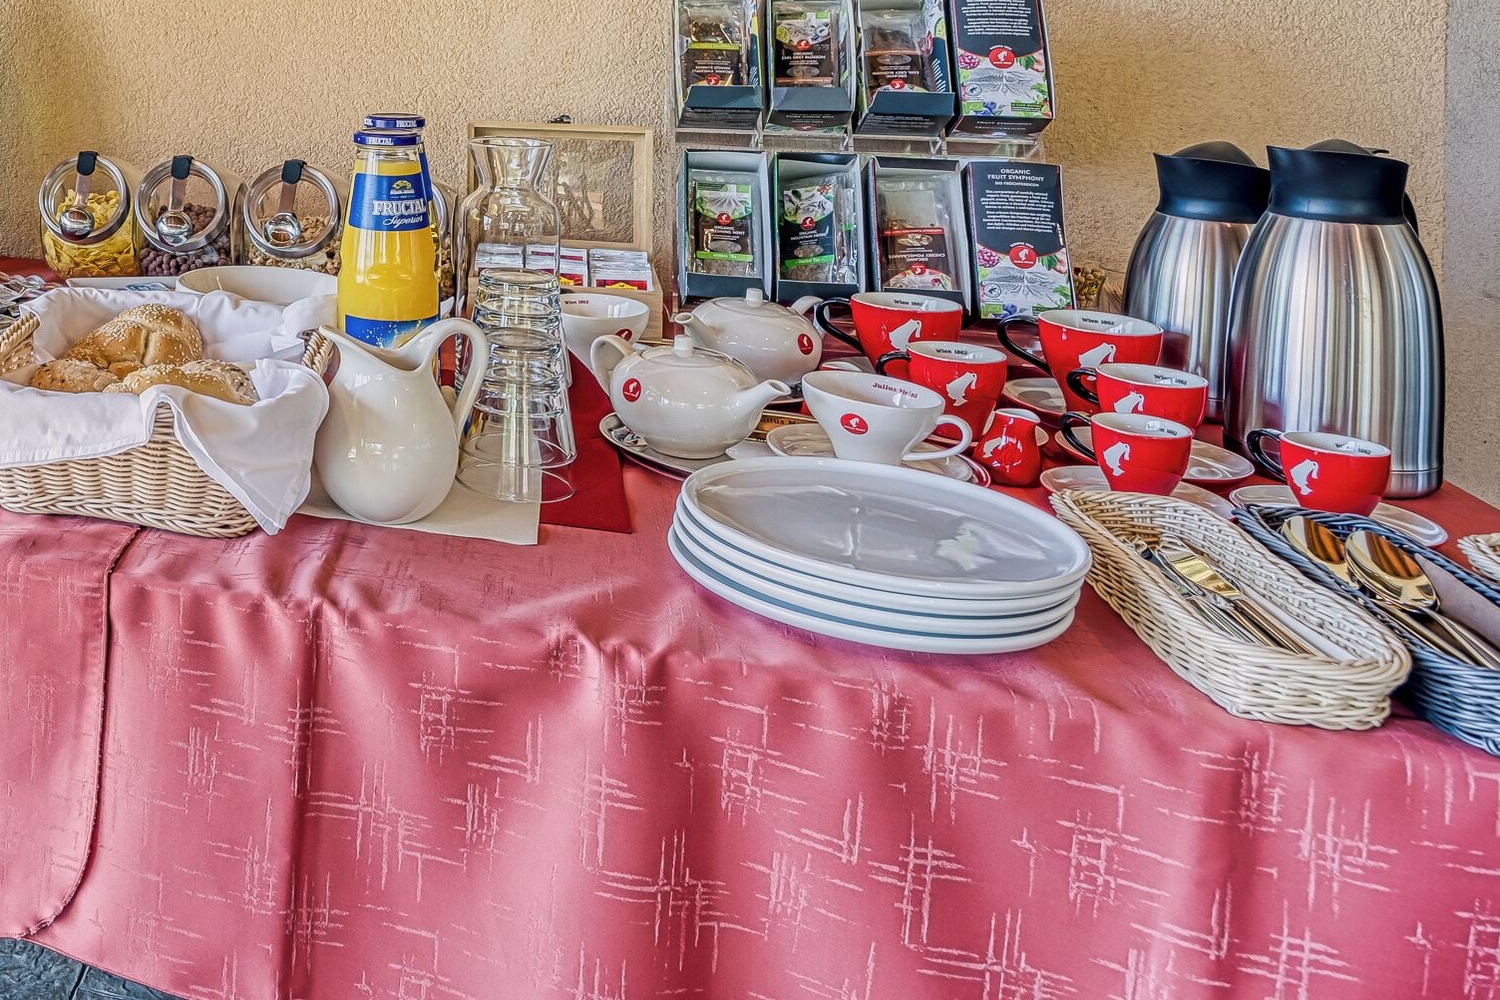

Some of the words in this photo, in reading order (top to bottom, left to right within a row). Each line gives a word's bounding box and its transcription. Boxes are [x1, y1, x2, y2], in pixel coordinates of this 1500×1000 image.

[367, 137, 394, 145] FRUCTAL
[372, 198, 426, 215] FRUCTAL
[382, 215, 423, 229] Superior
[872, 382, 897, 392] Julius
